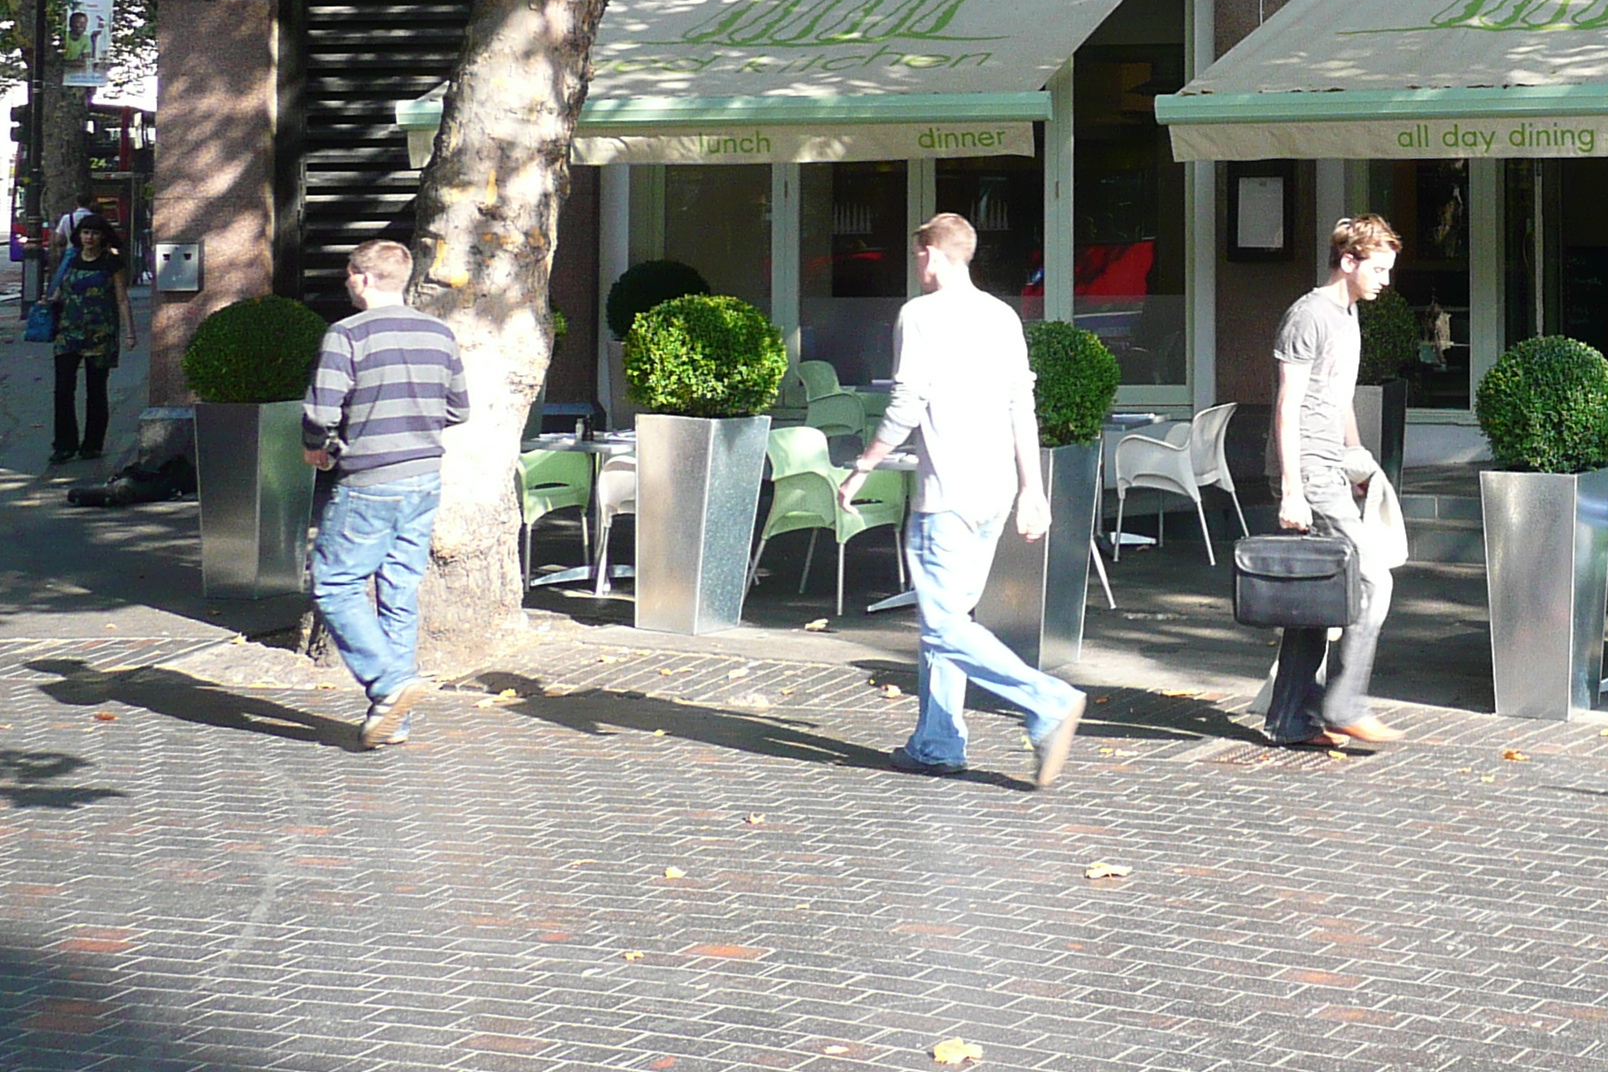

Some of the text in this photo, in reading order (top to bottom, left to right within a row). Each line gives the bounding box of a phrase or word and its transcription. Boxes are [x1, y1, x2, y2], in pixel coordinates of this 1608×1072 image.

[592, 44, 993, 74] ed kitchen
[699, 128, 1005, 155] lunch dinner
[1397, 122, 1595, 153] all day dining
